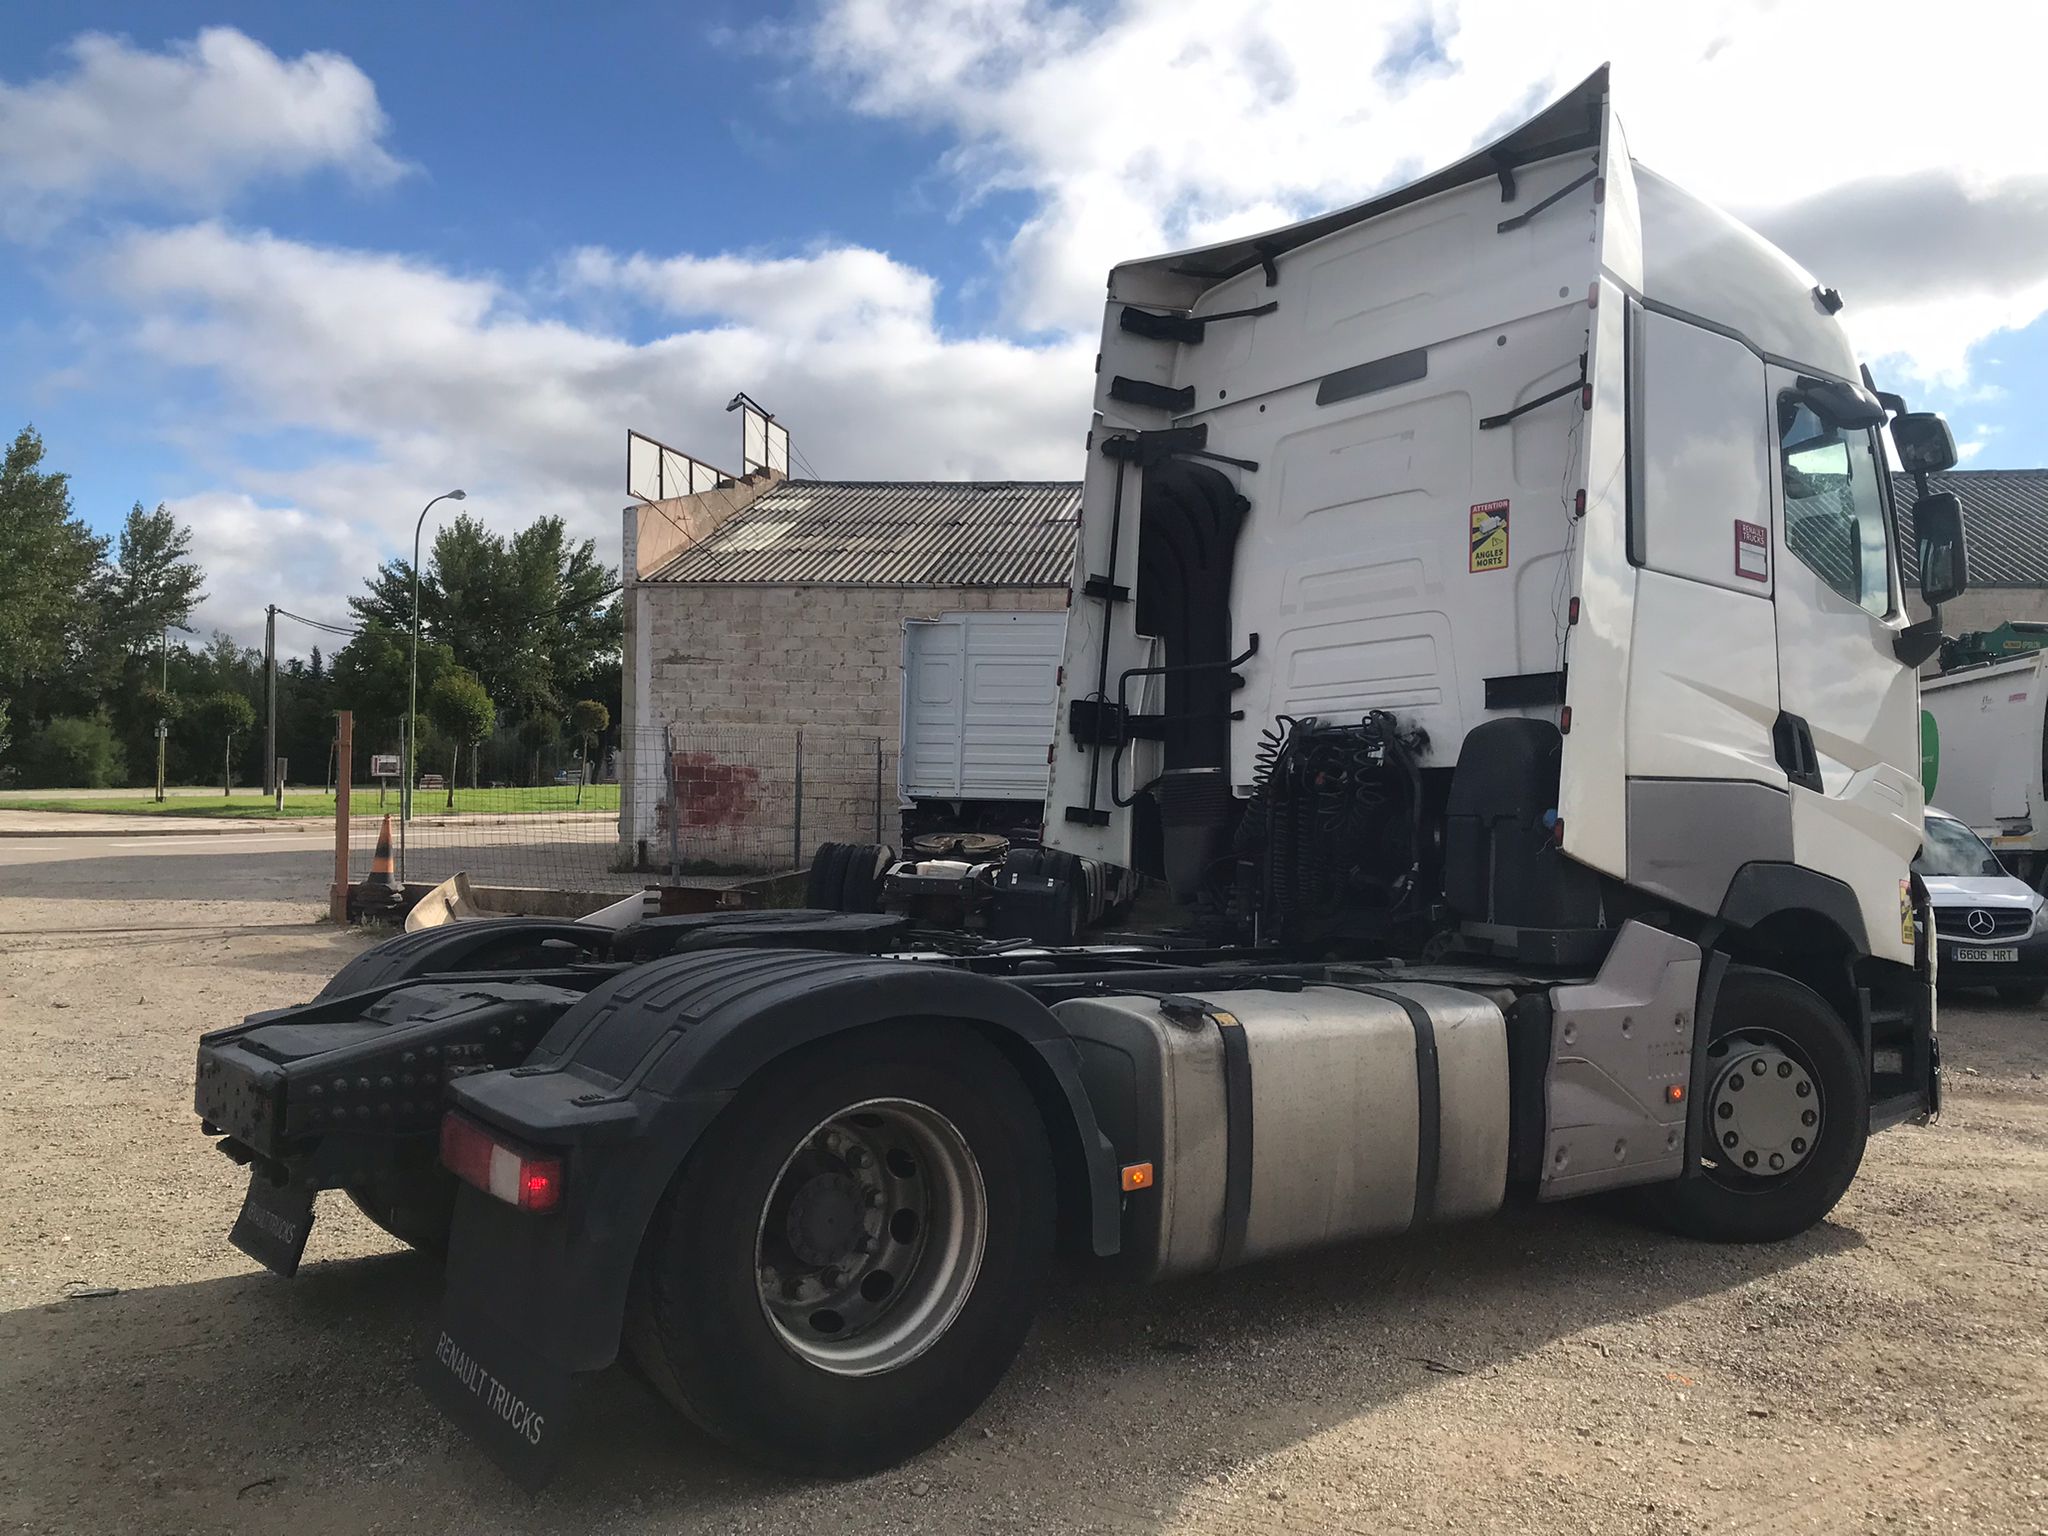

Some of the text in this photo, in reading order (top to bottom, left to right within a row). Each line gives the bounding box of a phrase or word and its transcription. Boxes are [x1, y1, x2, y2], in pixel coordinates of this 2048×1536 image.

[1472, 501, 1508, 513] ATTENTION
[1743, 532, 1765, 545] TRUCKS
[1475, 548, 1504, 560] ANGLES
[1476, 557, 1502, 567] MORTS
[1960, 950, 2012, 961] 6606 HRT
[436, 1331, 545, 1445] RENAULT TRUCKS
